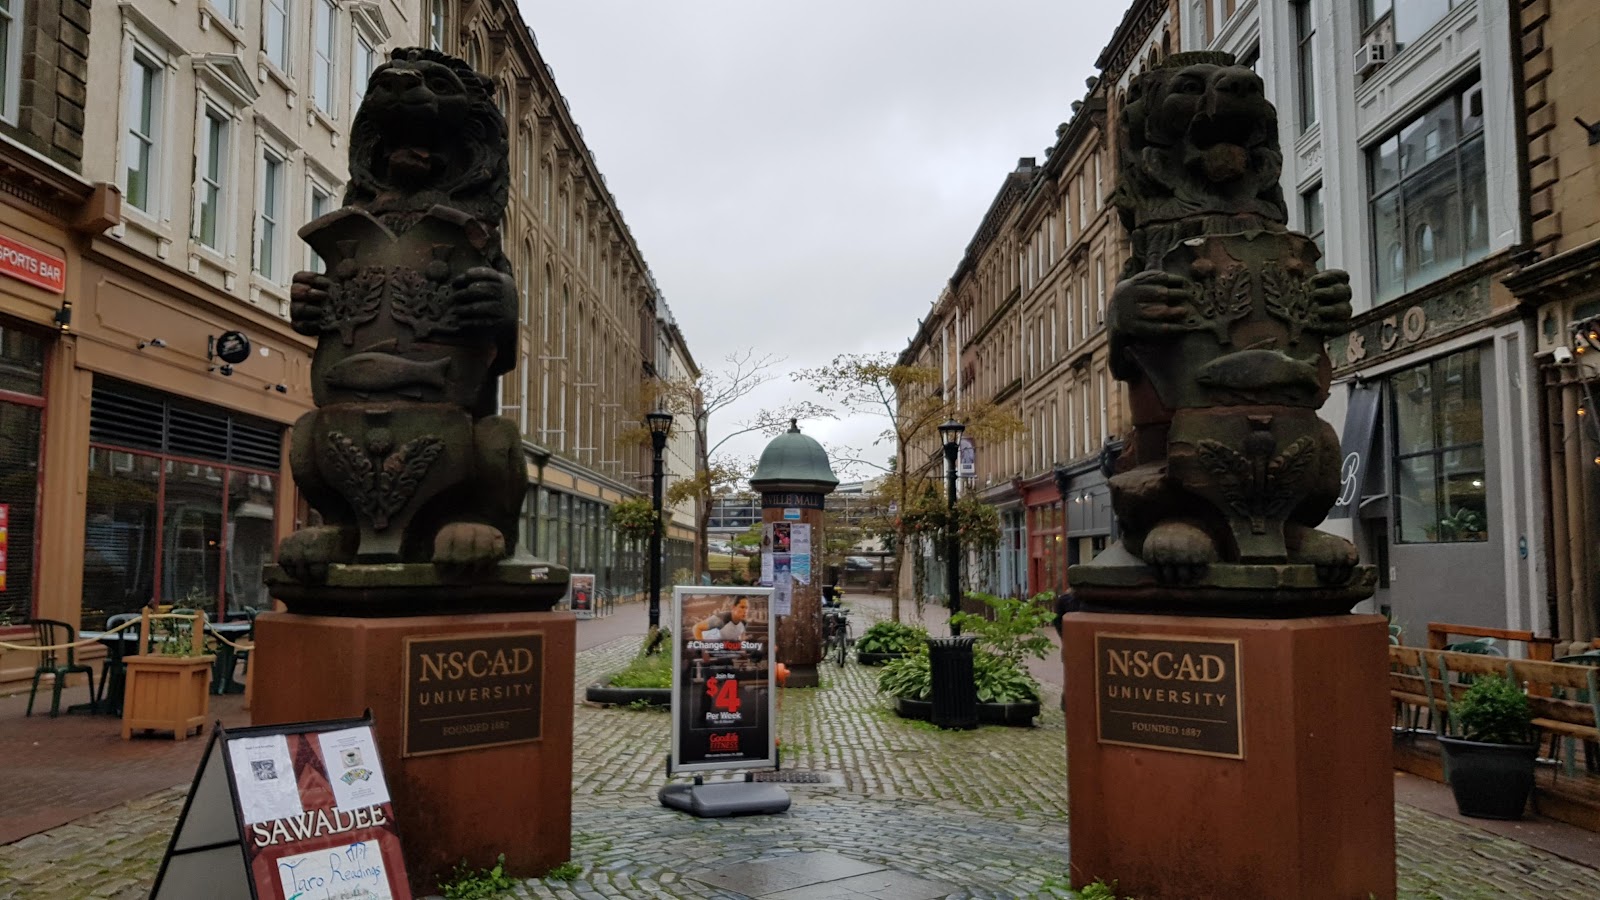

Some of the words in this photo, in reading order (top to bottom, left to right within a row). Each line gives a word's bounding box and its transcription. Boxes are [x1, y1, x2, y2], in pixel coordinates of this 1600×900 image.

[40, 261, 61, 283] BAR
[420, 684, 534, 705] UNIVERSITY
[706, 676, 742, 712] $4
[1108, 685, 1226, 707] UNIVERSITY
[706, 712, 720, 720] Per
[720, 711, 742, 720] Week
[443, 722, 489, 736] FOUNDED
[1132, 721, 1179, 735] FOUNDED
[1181, 728, 1202, 738] 1887
[710, 741, 739, 750] FITNESS
[252, 804, 387, 848] SAWADEE
[279, 857, 324, 893] Taro
[329, 852, 381, 886] Readings
